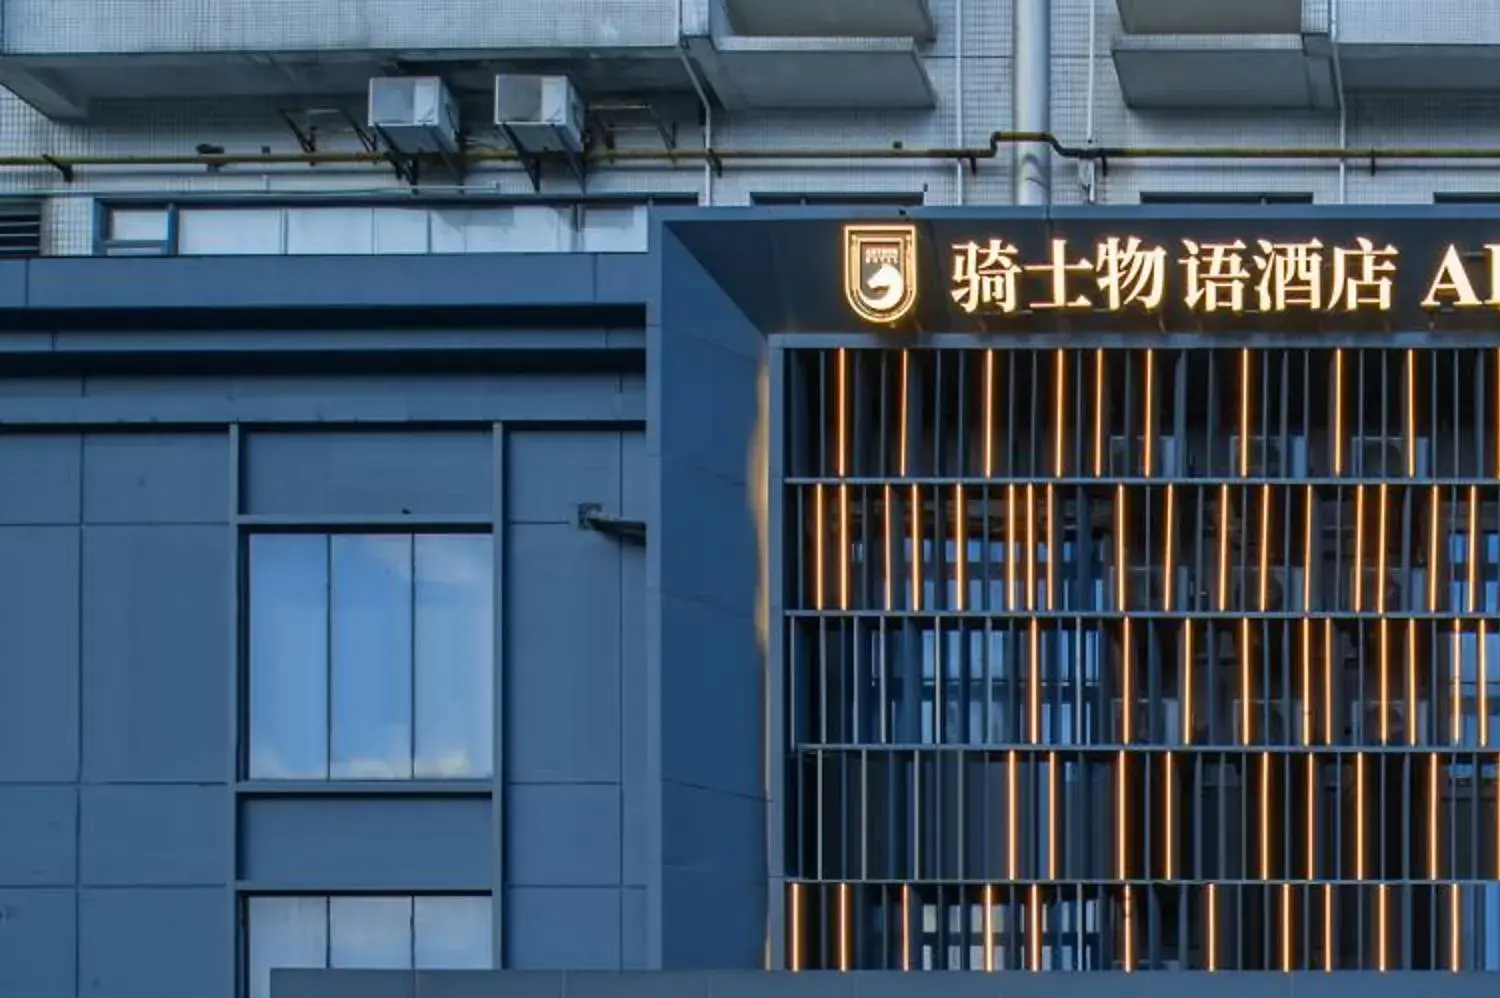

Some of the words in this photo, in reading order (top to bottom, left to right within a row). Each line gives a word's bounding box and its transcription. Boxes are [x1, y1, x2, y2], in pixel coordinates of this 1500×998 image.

[950, 236, 1399, 313] 骑士物语酒店
